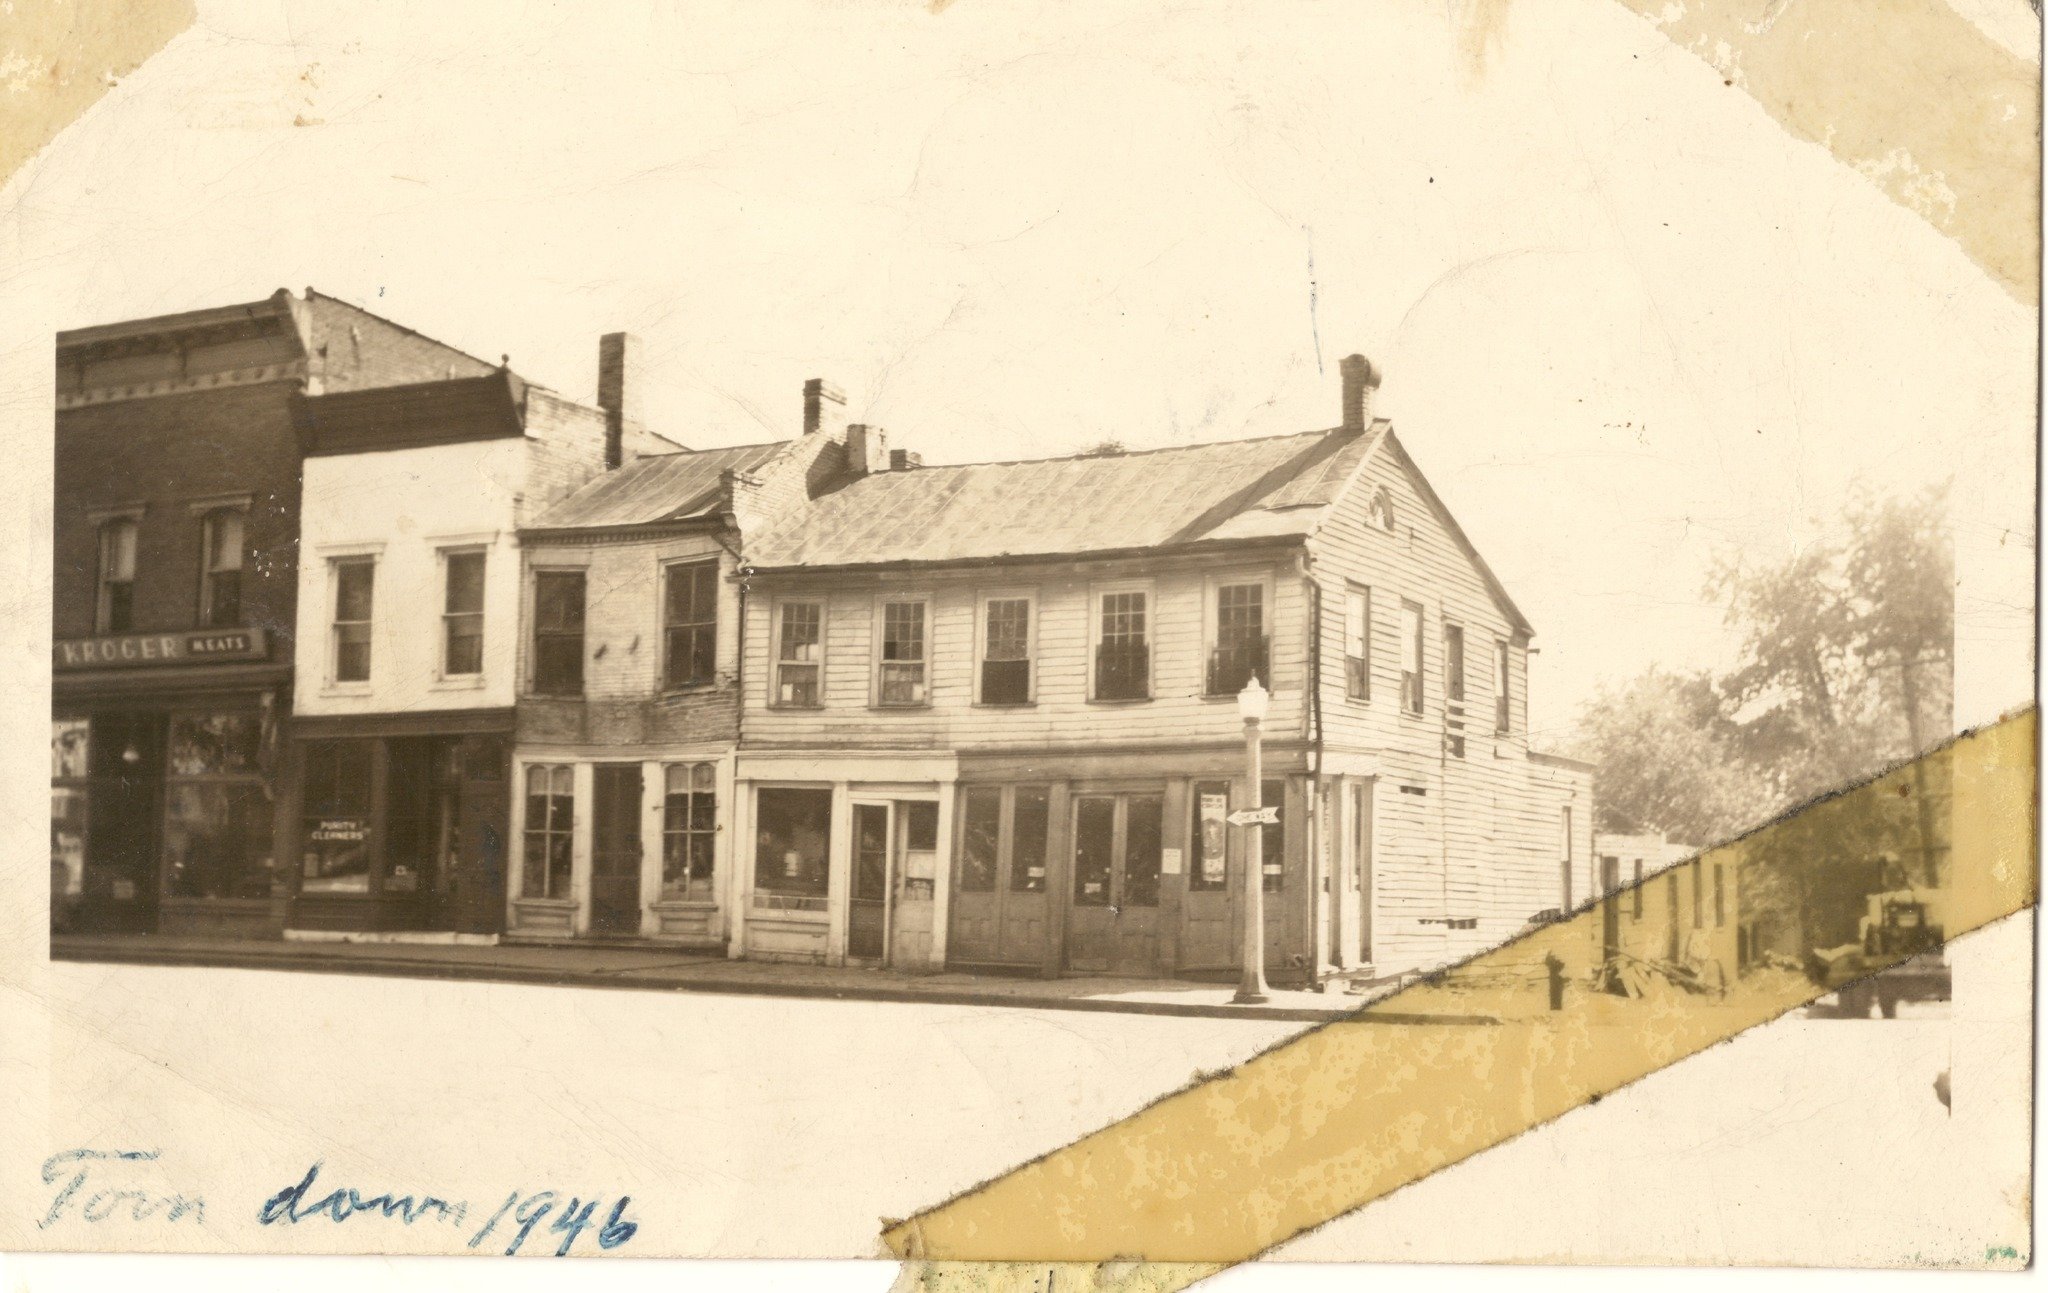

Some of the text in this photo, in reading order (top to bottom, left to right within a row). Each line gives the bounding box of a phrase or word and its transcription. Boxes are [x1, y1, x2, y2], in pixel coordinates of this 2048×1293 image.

[62, 636, 245, 664] KROGER MEATS
[311, 830, 364, 840] CLEANERS
[37, 1147, 640, 1257] Torn down 1946
